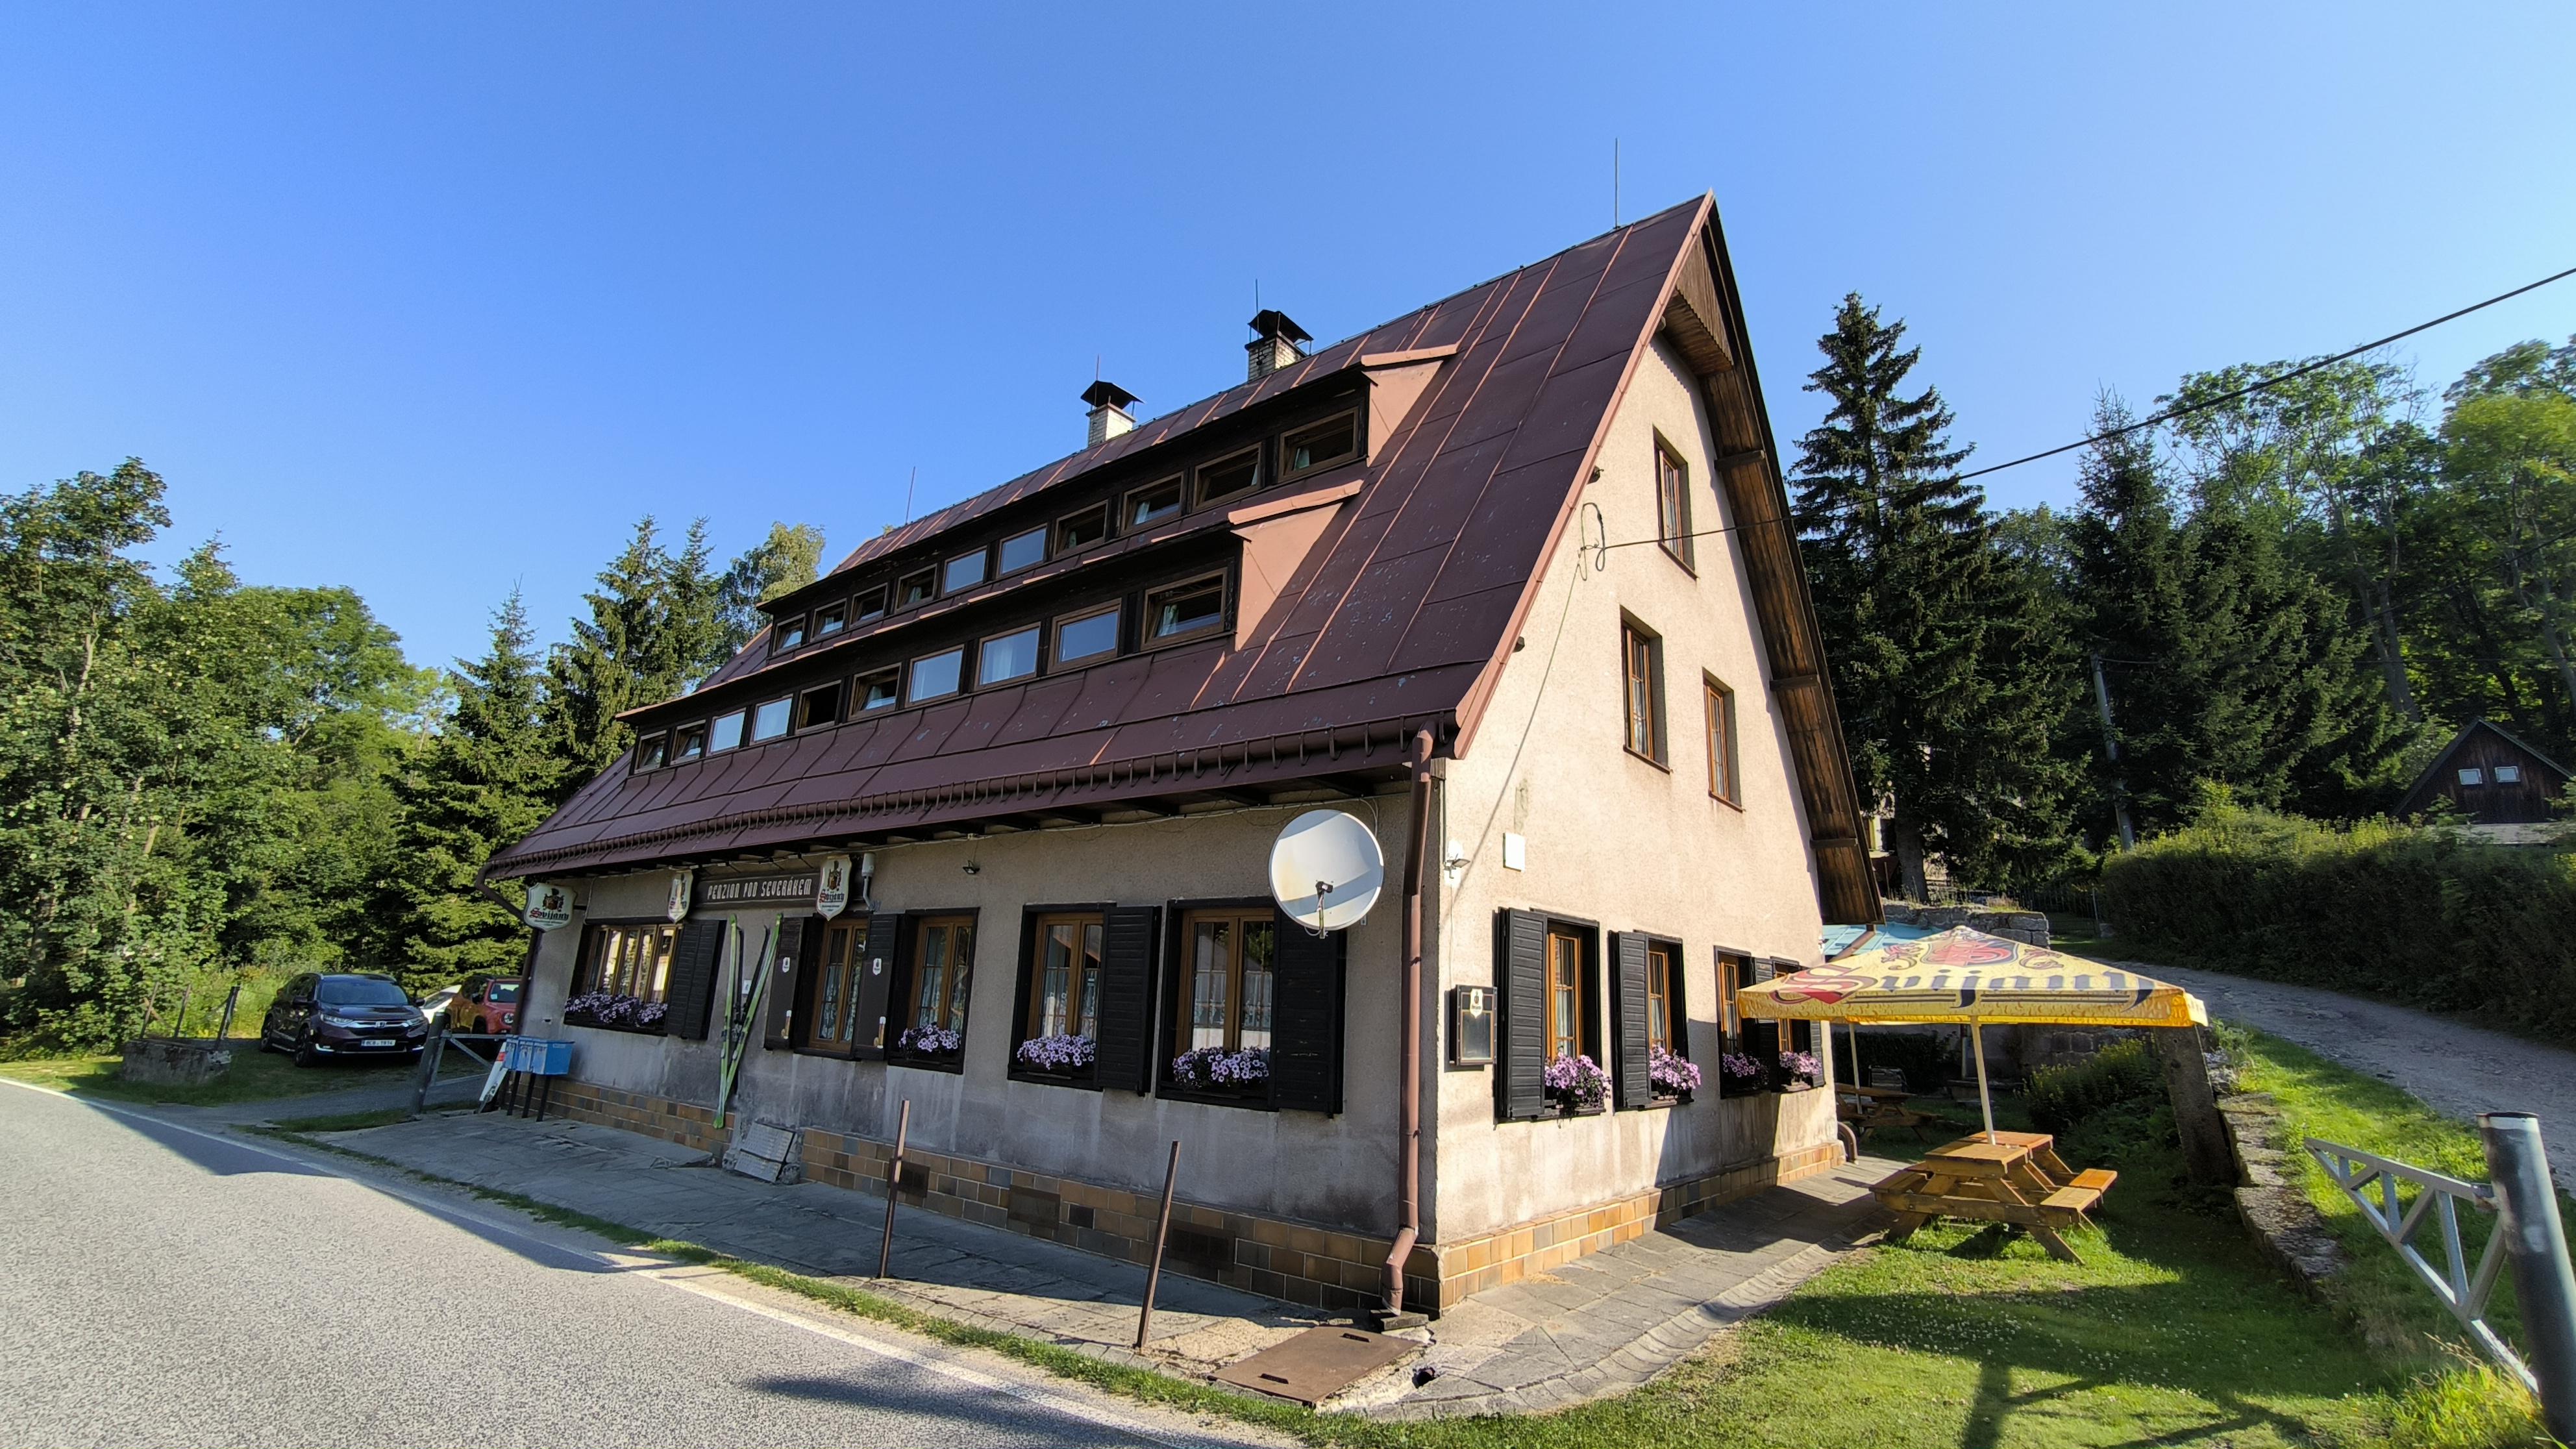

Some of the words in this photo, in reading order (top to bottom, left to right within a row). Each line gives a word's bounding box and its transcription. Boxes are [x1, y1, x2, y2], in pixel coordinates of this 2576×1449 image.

[707, 884, 740, 900] PENZION
[760, 876, 812, 897] SEVERÁKEM
[819, 889, 845, 902] Svijany
[529, 908, 569, 921] Svijany
[1769, 964, 2154, 1013] Svijany
